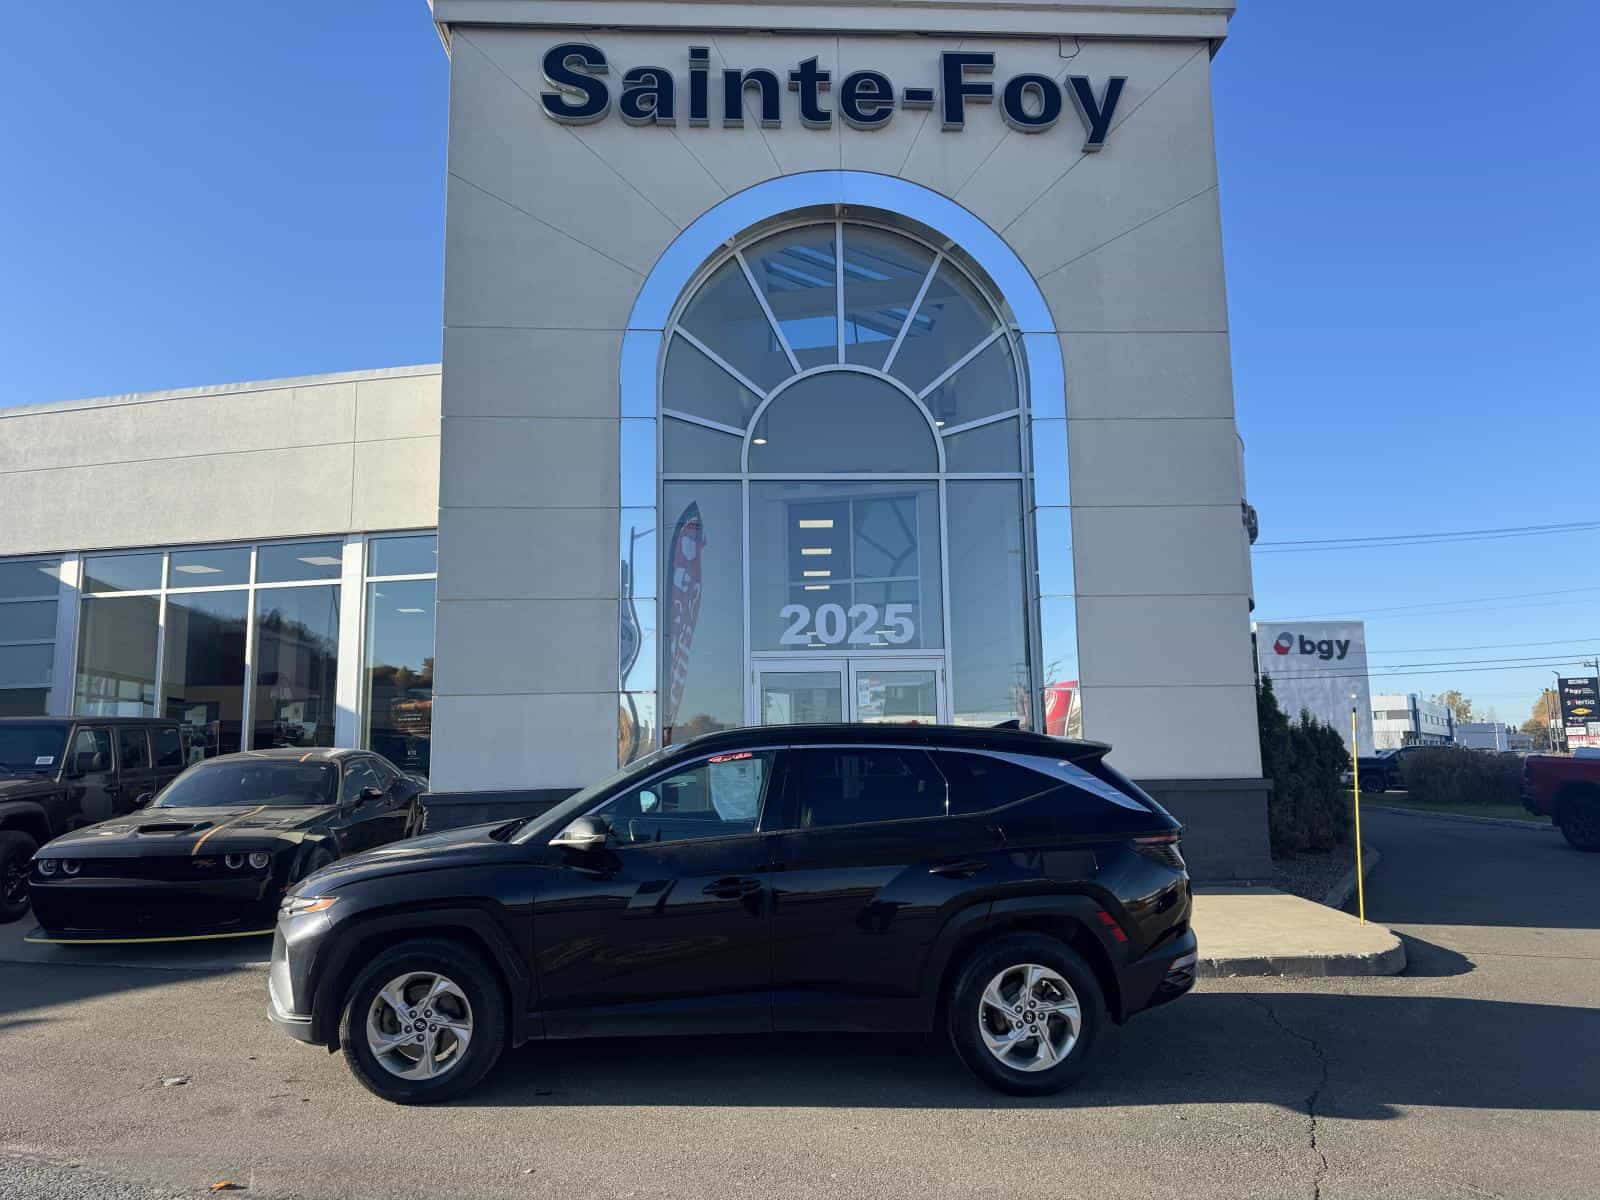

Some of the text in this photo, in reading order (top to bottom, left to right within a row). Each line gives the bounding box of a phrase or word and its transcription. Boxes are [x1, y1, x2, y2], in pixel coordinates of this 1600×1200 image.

[540, 42, 1127, 152] Sainte-Foy
[779, 603, 915, 645] 2025
[1298, 635, 1351, 660] bgy
